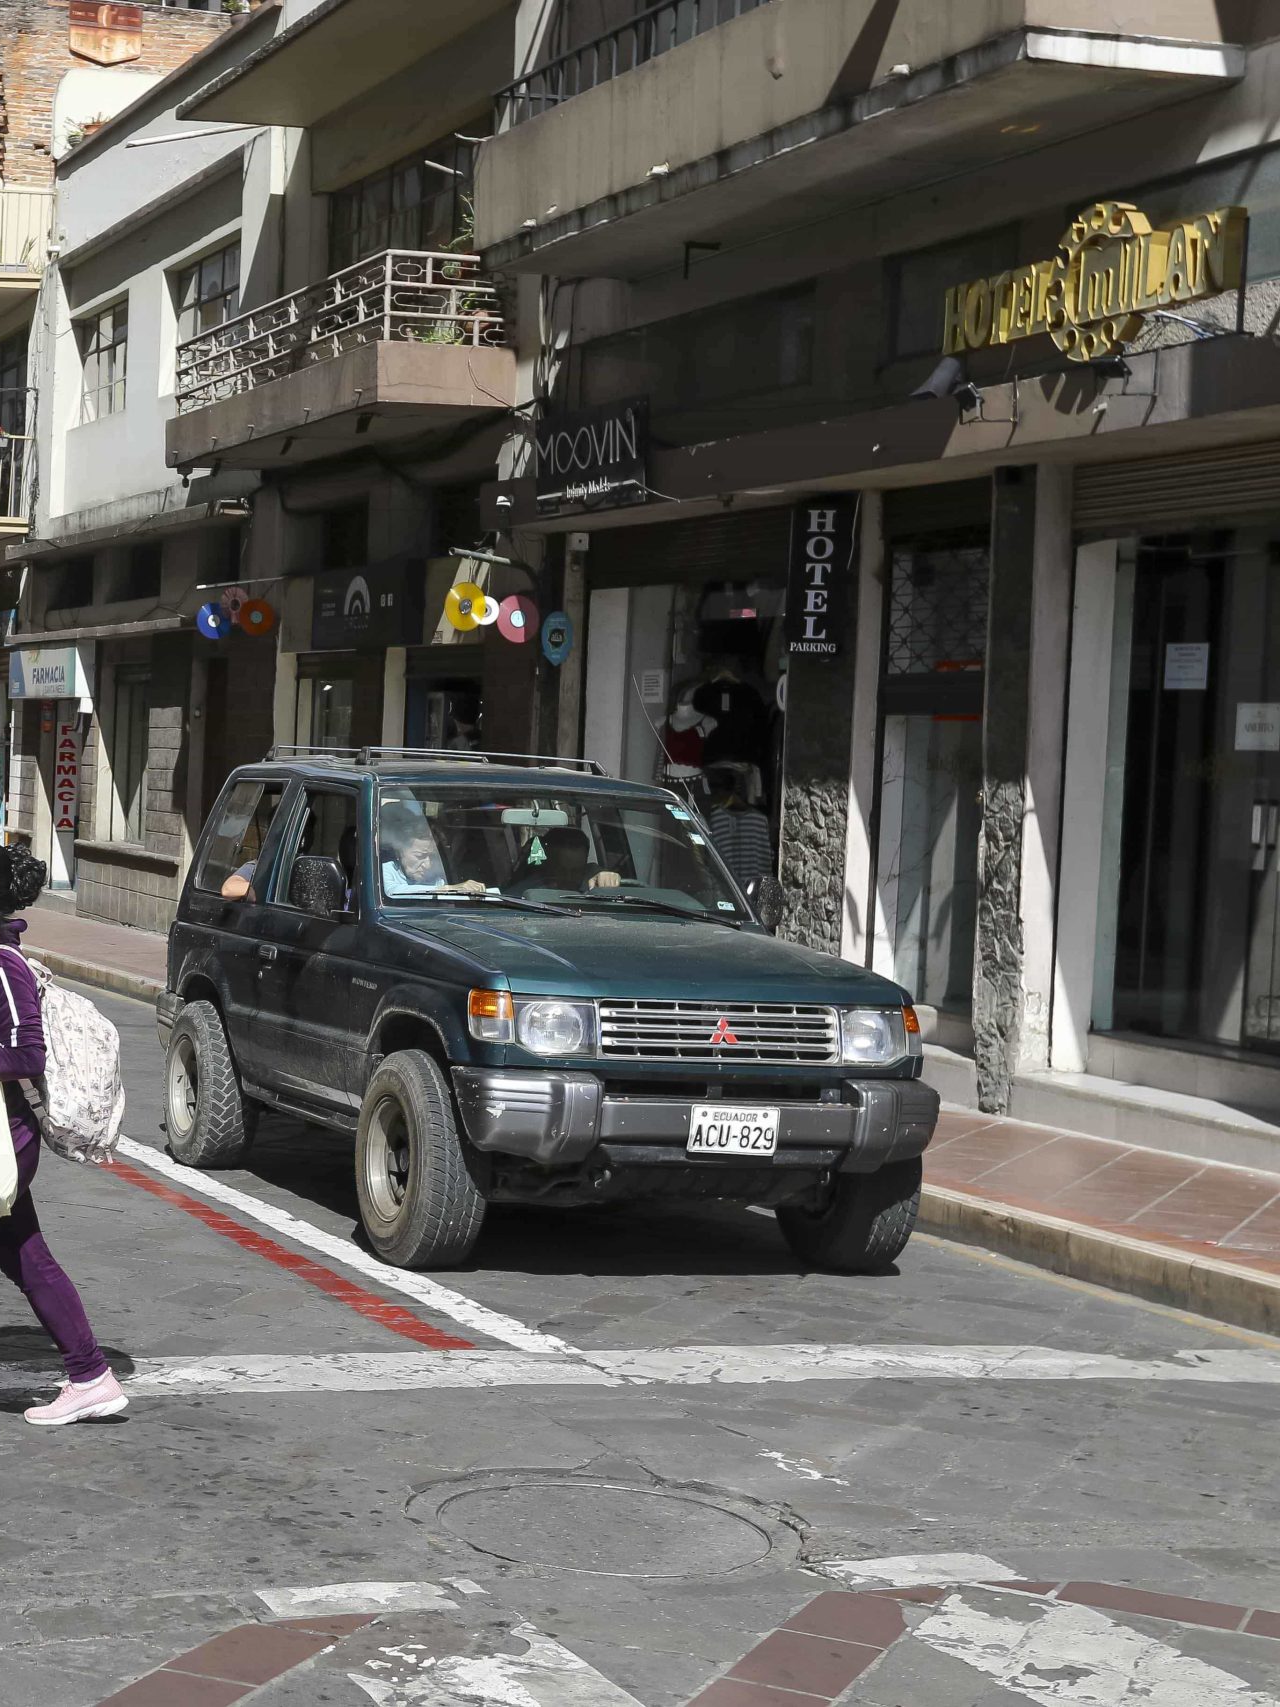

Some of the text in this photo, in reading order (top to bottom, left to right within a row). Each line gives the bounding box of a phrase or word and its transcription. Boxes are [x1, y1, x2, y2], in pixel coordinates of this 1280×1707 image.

[942, 260, 1050, 356] HOTEL
[802, 509, 837, 639] HOTEL
[789, 641, 837, 653] PARKING
[32, 665, 65, 684] FARMACIA
[56, 725, 77, 828] FARMACIA
[713, 1111, 758, 1122] ECUADOR
[692, 1124, 775, 1150] ACU-829
